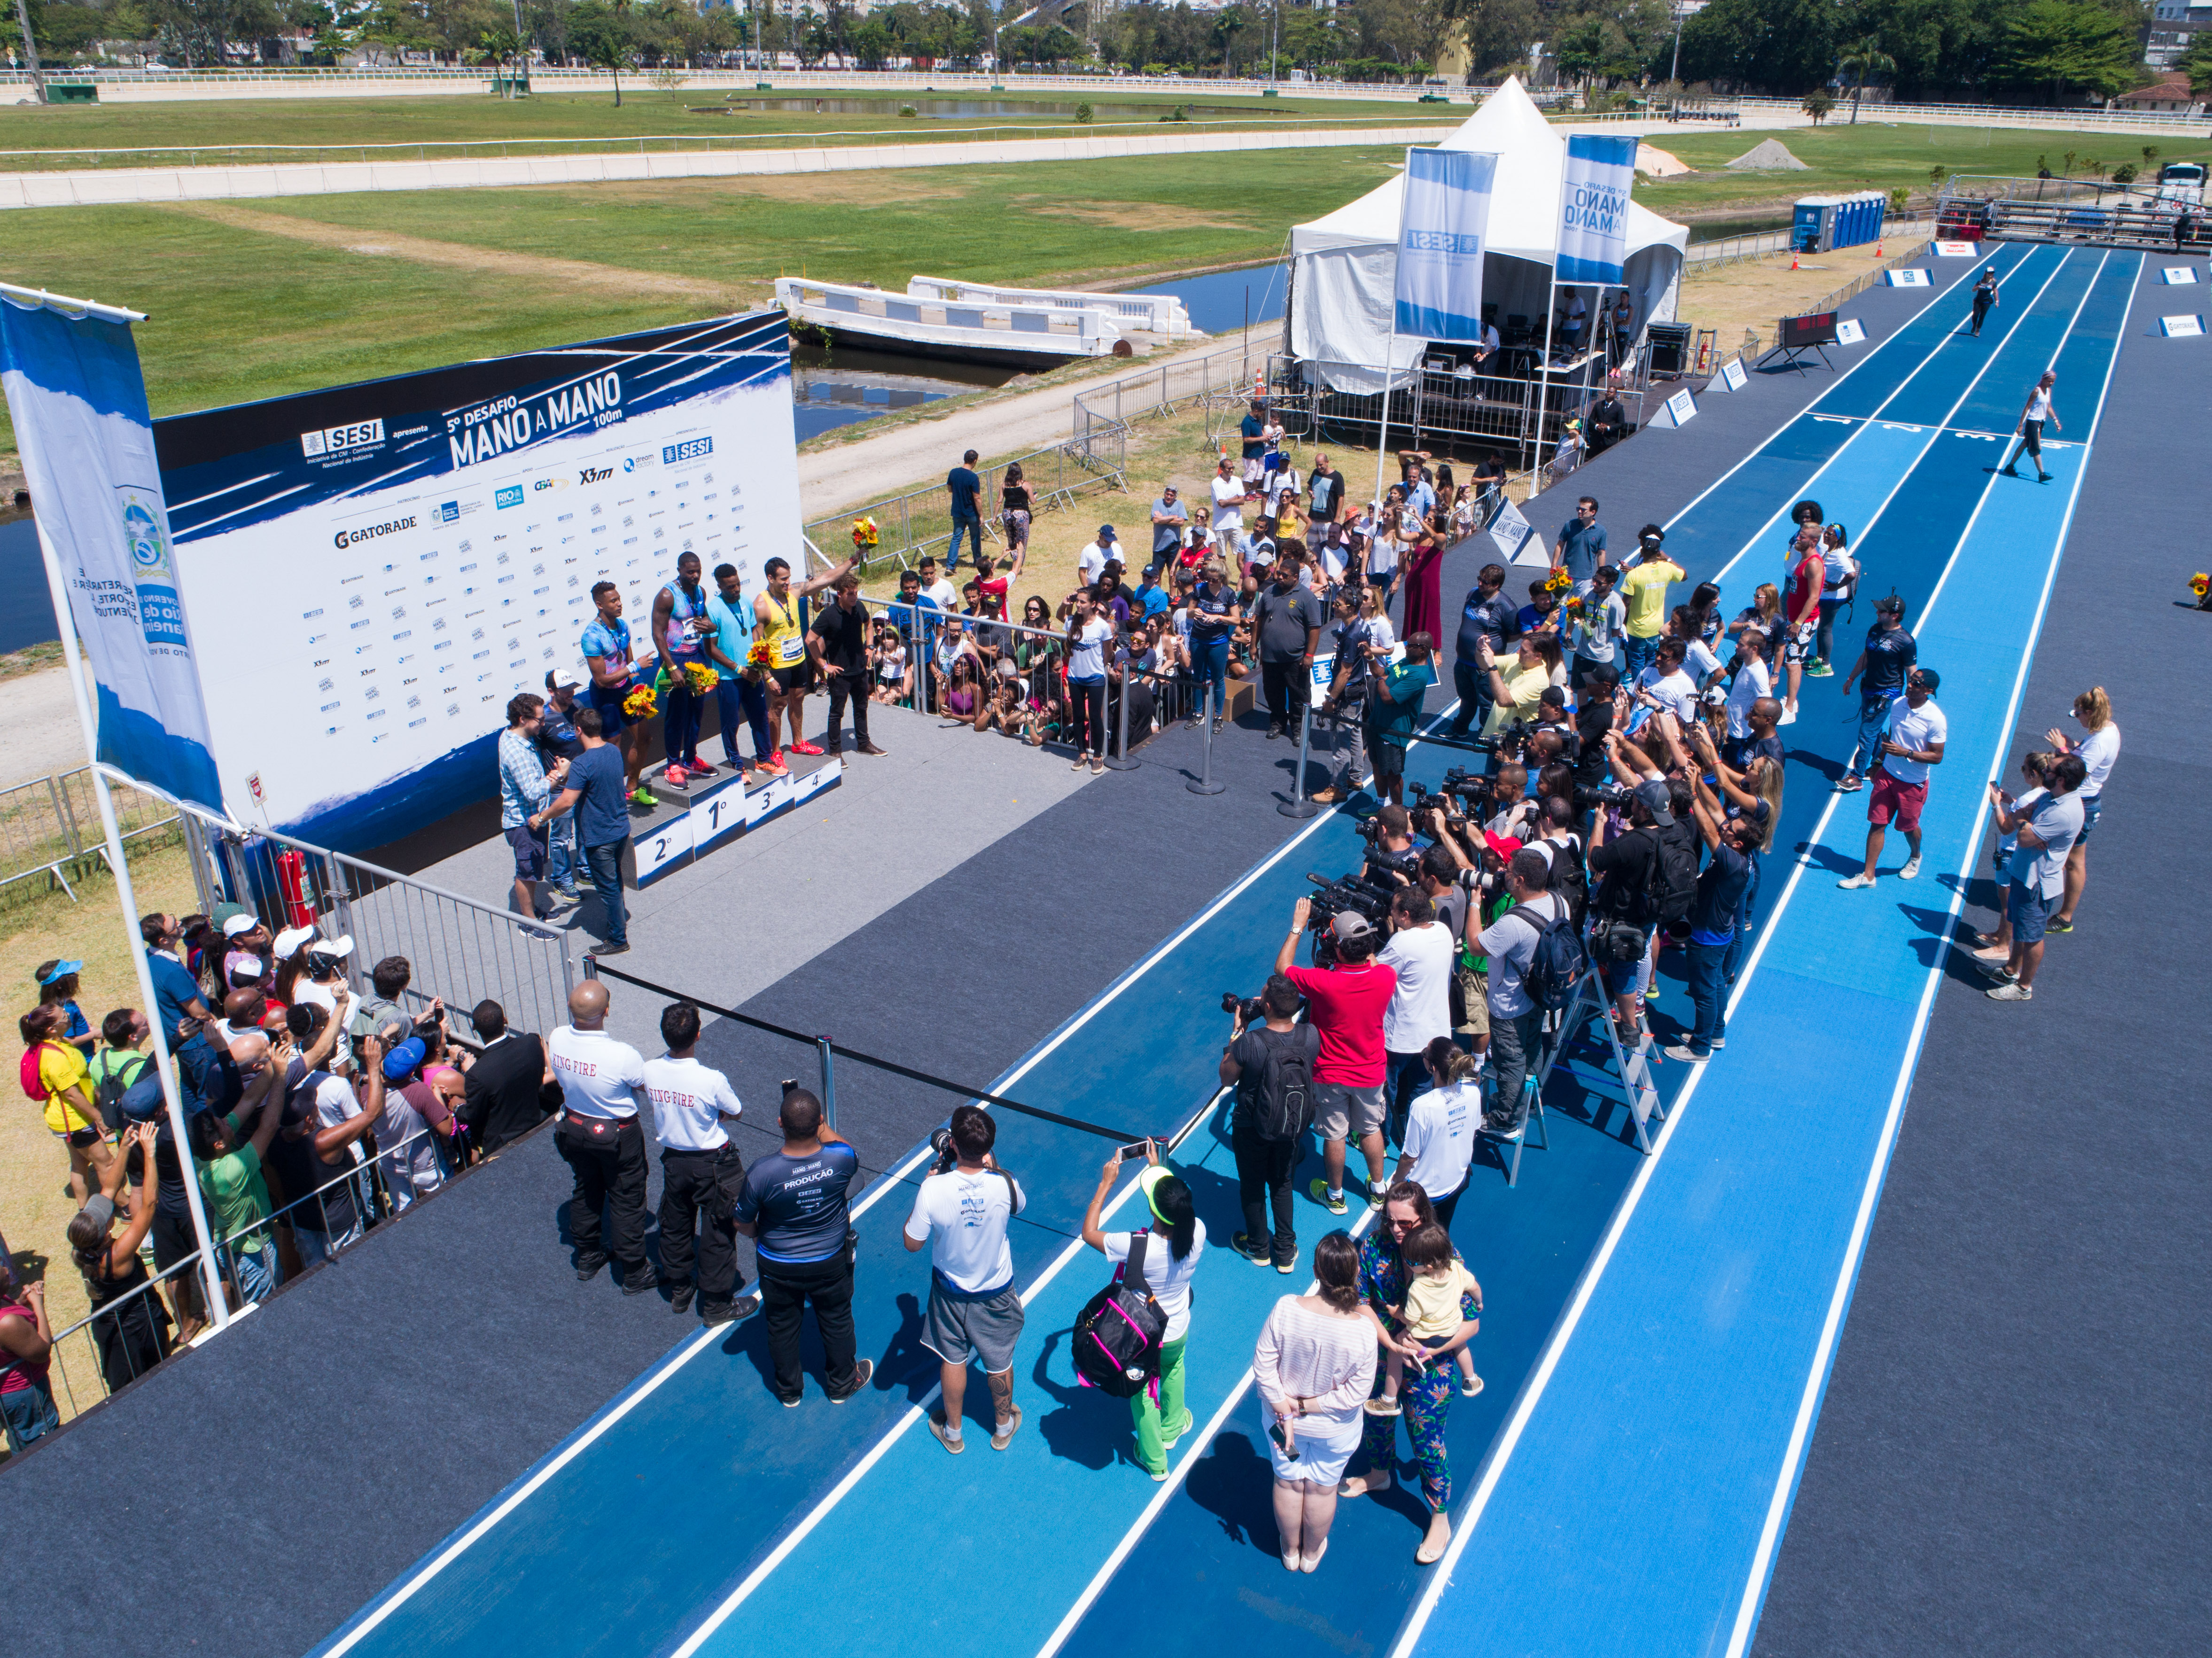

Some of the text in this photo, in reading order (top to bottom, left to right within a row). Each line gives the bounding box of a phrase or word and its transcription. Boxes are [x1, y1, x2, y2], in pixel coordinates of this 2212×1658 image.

[447, 396, 517, 433] 5º DESAFIO
[450, 372, 621, 471] MANO A MANO
[593, 409, 622, 428] 100m
[1813, 416, 1851, 424] 1
[333, 423, 377, 448] SESI
[393, 425, 428, 438] apresenta
[1882, 423, 1921, 433] 2
[1955, 432, 1995, 441] 3
[307, 455, 330, 464] Iniciativa
[352, 443, 386, 455] Confederação
[681, 438, 710, 459] SESI
[322, 459, 344, 468] Nacional
[352, 453, 374, 462] Indústria
[636, 454, 654, 463] dream
[636, 459, 654, 469] factory
[397, 495, 421, 505] PATROCÍNIO
[497, 490, 514, 503] RIO
[498, 498, 522, 507] PREFEITURA
[350, 516, 417, 543] GATORADE
[1494, 520, 1526, 539] MANO MANO
[812, 774, 821, 786] 4º
[762, 791, 775, 810] 3º
[708, 800, 727, 830] 1º
[654, 837, 672, 862] 2º
[553, 1052, 597, 1077] KING FIRE
[648, 1088, 694, 1107] KING FIRE
[784, 1168, 833, 1190] PRODUÇÃO
